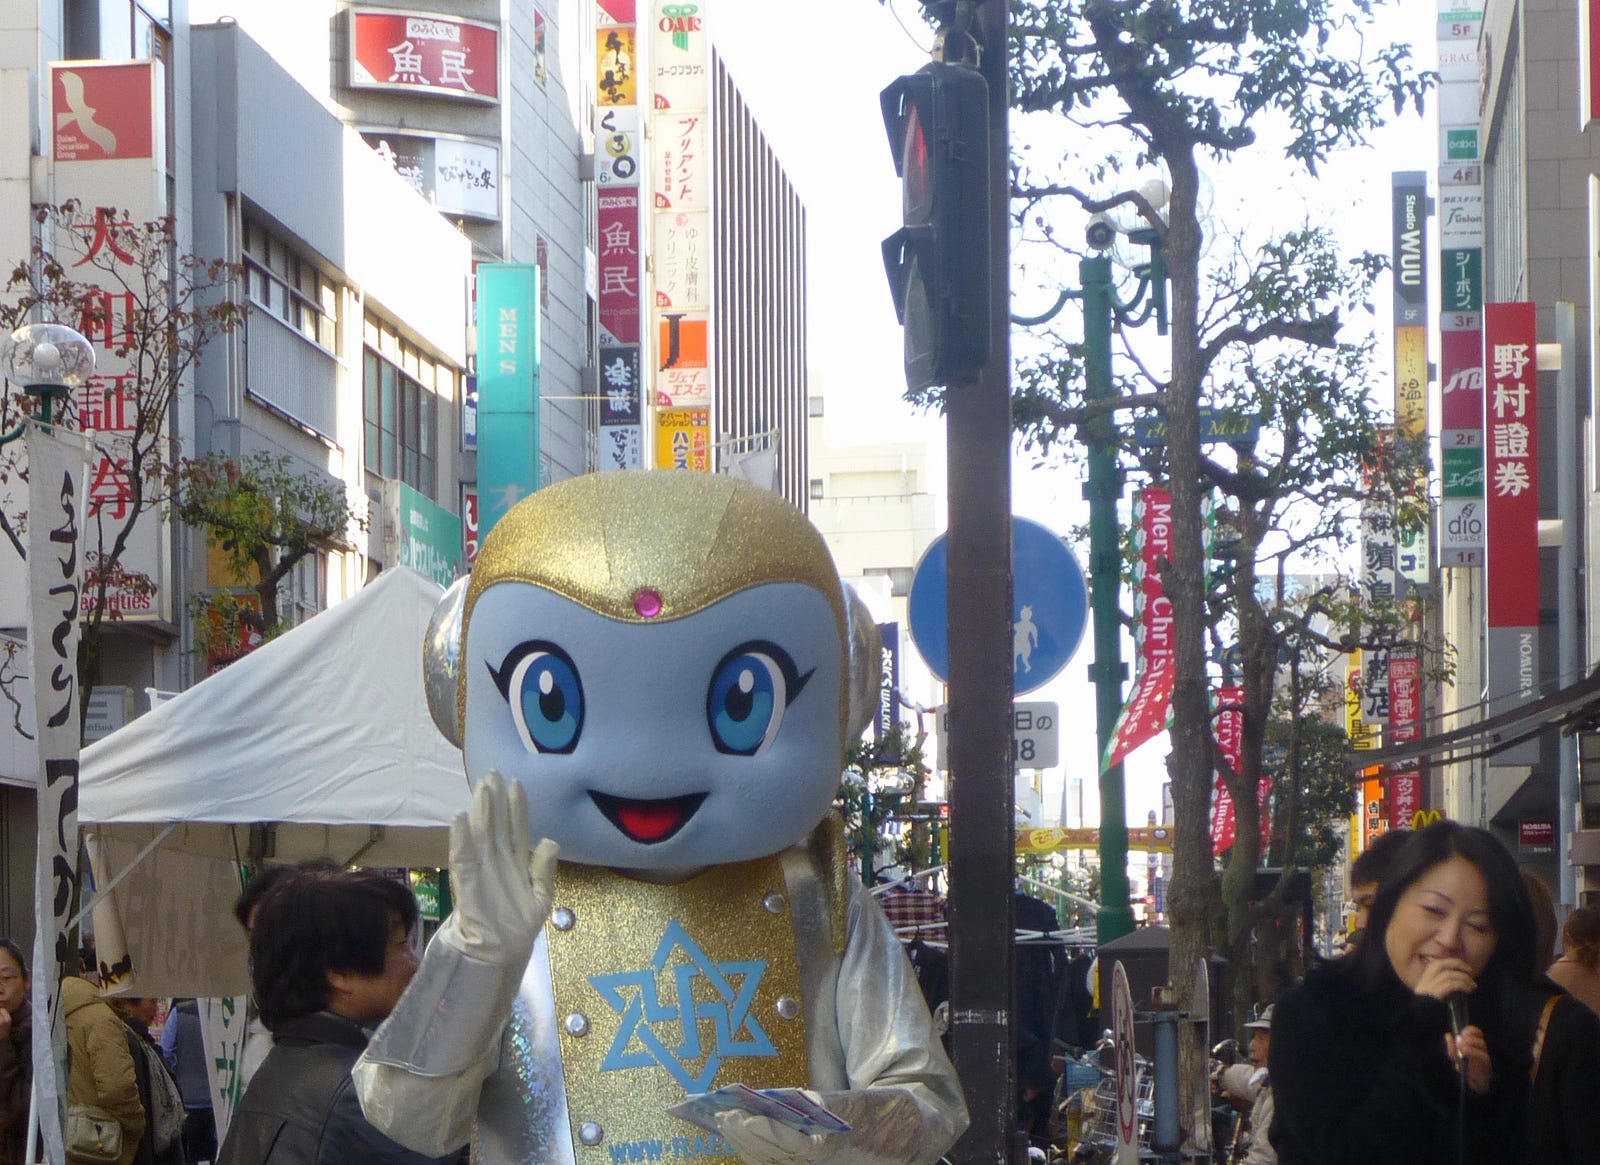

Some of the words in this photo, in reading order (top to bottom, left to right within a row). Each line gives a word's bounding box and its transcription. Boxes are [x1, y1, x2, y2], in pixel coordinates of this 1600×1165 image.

[1451, 23, 1471, 36] 5F
[387, 40, 476, 92] 魚民
[677, 117, 699, 201] ブリアント
[1453, 168, 1472, 182] 4F
[1406, 194, 1416, 230] Studio
[601, 221, 638, 297] 魚民
[664, 228, 677, 293] クリニック
[685, 228, 699, 304] ゆり皮膚科
[1455, 315, 1474, 328] 3F
[73, 206, 137, 519] 大和証券
[1443, 366, 1483, 394] JTB
[671, 384, 706, 396] エステ
[1493, 343, 1530, 497] 野村證券
[673, 431, 689, 469] ハウス
[1456, 434, 1475, 445] 2F
[1457, 552, 1475, 563] 1F
[80, 592, 150, 611] ecrities
[1520, 633, 1532, 698] NOMURA
